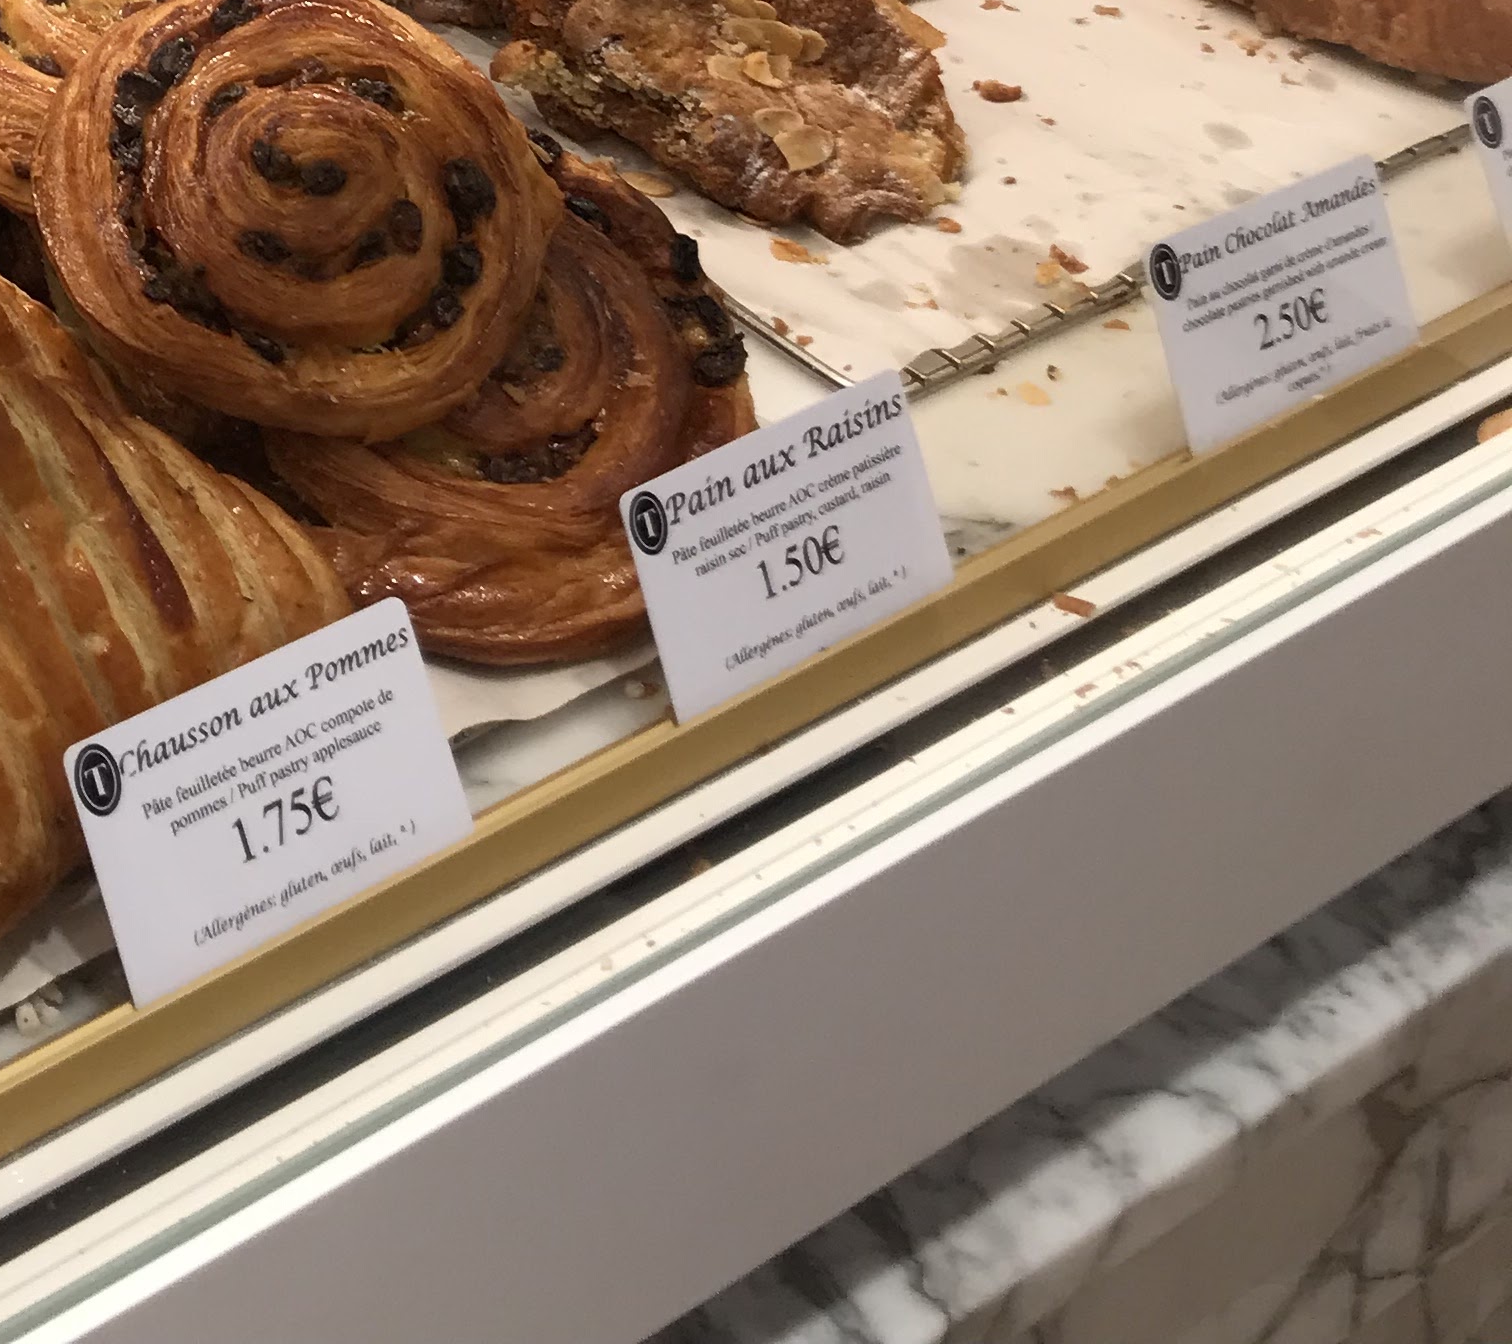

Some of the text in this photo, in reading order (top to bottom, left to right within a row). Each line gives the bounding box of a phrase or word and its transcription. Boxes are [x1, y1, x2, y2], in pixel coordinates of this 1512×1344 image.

[1253, 287, 1328, 351] 2.50€
[665, 393, 903, 526] Pain aux Raisins
[756, 524, 844, 600] 1.50€
[118, 627, 409, 777] Chausson aux Pommes
[232, 775, 340, 863] 1.75€
